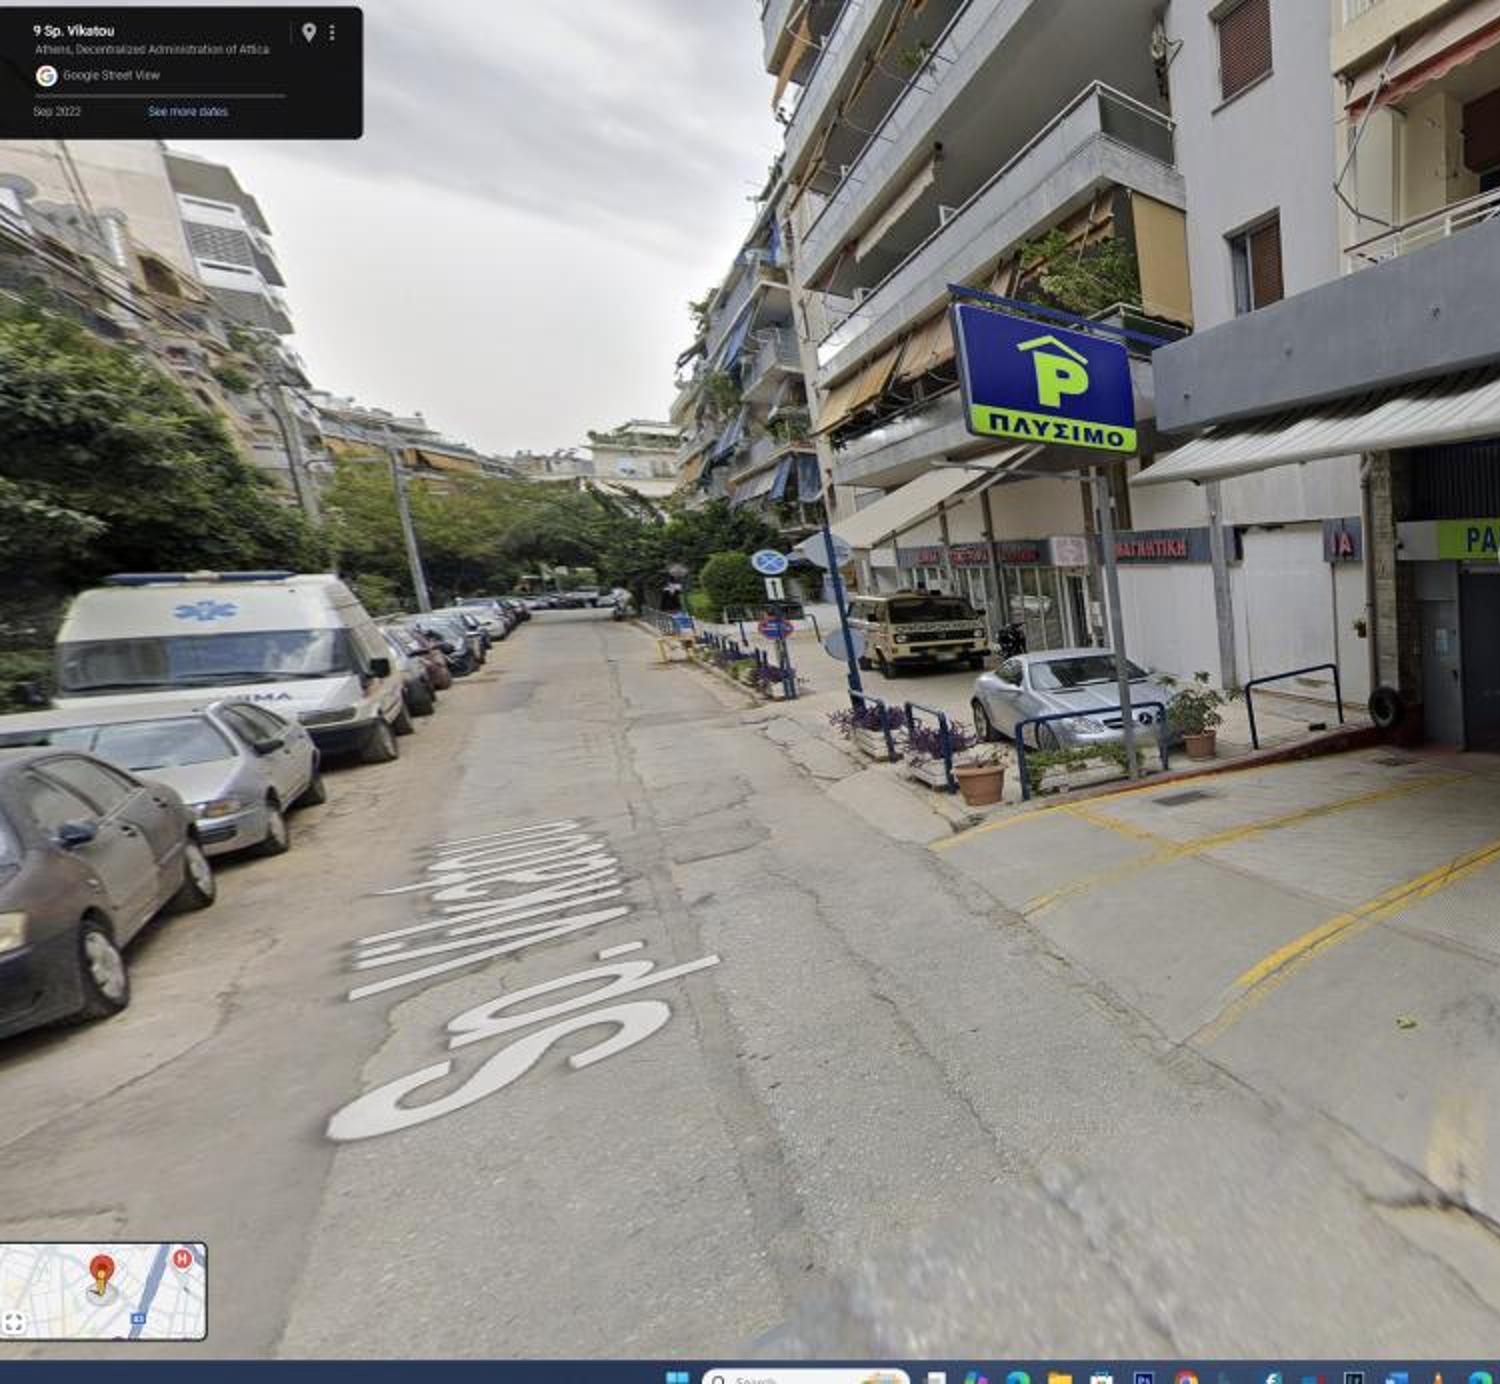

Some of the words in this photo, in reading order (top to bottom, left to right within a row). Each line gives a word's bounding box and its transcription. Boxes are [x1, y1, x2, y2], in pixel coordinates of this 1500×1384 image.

[1033, 350, 1090, 409] P
[989, 413, 1125, 448] ΠΛΥΣΙΜΟ
[1112, 538, 1185, 558] ΑΓΝΗΤΙΚΗ
